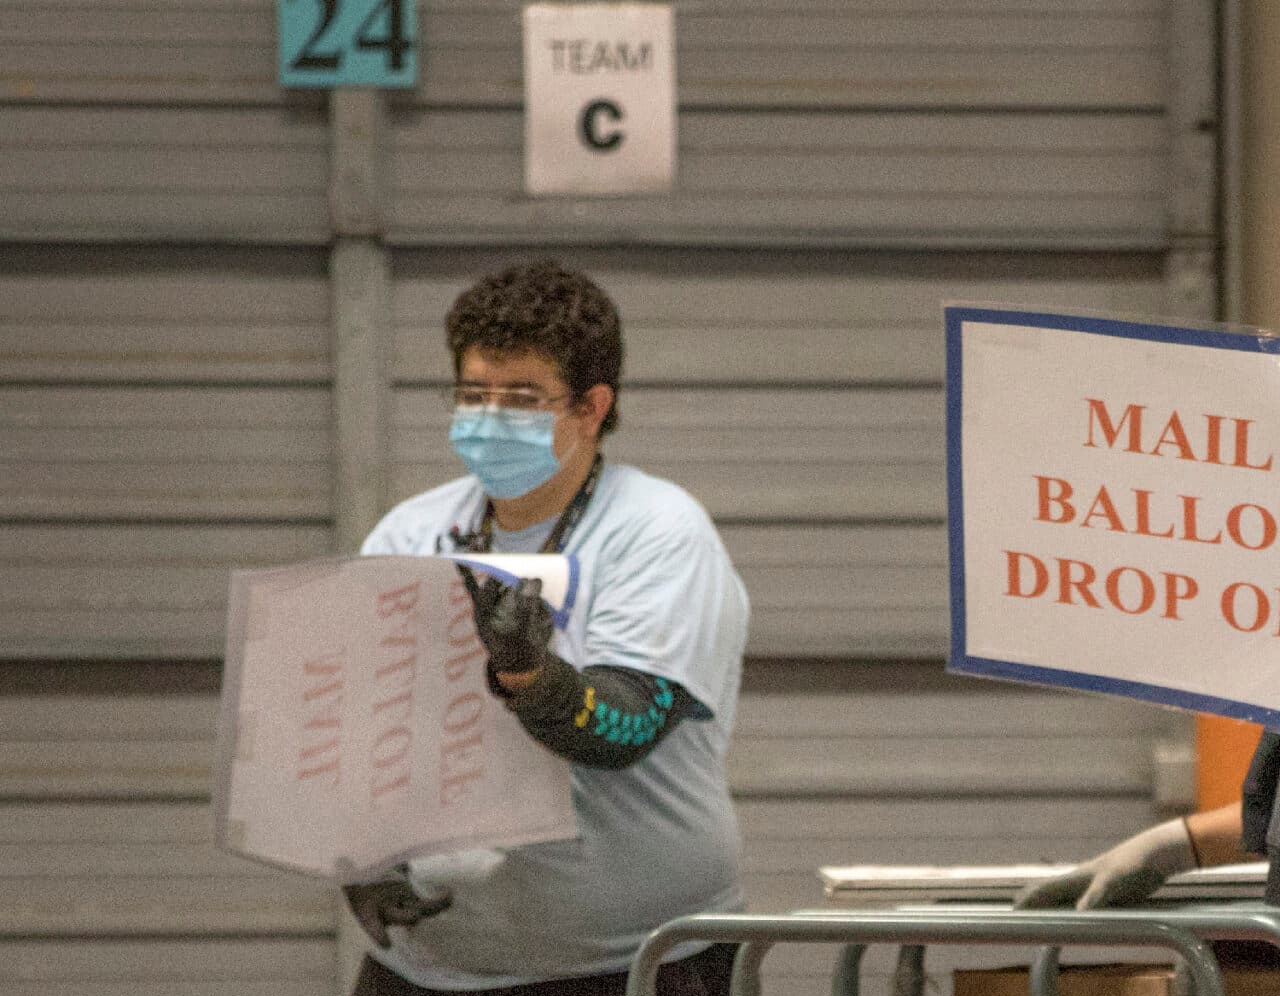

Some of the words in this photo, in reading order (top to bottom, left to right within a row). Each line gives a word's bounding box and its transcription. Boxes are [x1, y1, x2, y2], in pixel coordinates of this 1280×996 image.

[290, 0, 413, 72] 24
[548, 39, 654, 75] TEAM
[577, 98, 624, 153] C
[1083, 397, 1274, 472] MAIL
[1003, 549, 1199, 621] DROP
